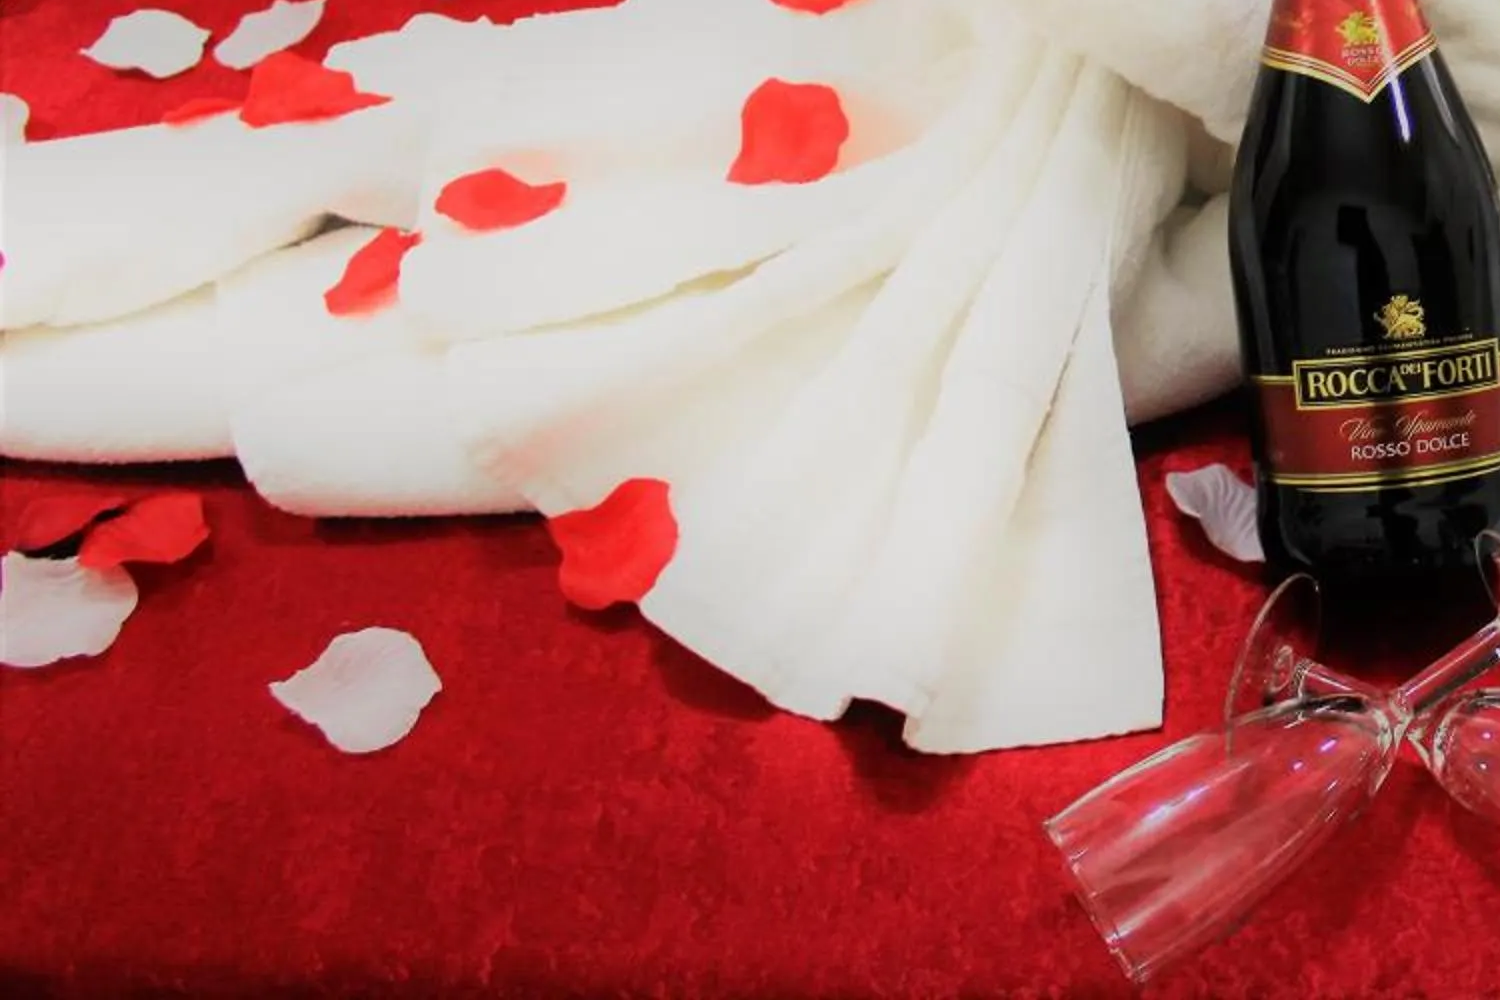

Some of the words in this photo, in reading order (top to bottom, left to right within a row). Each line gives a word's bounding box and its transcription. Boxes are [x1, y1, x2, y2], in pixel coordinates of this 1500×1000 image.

[1307, 364, 1407, 399] ROCCA
[1422, 350, 1492, 389] FORTI
[1351, 440, 1411, 461] ROSSO
[1416, 431, 1471, 453] DOLCE
